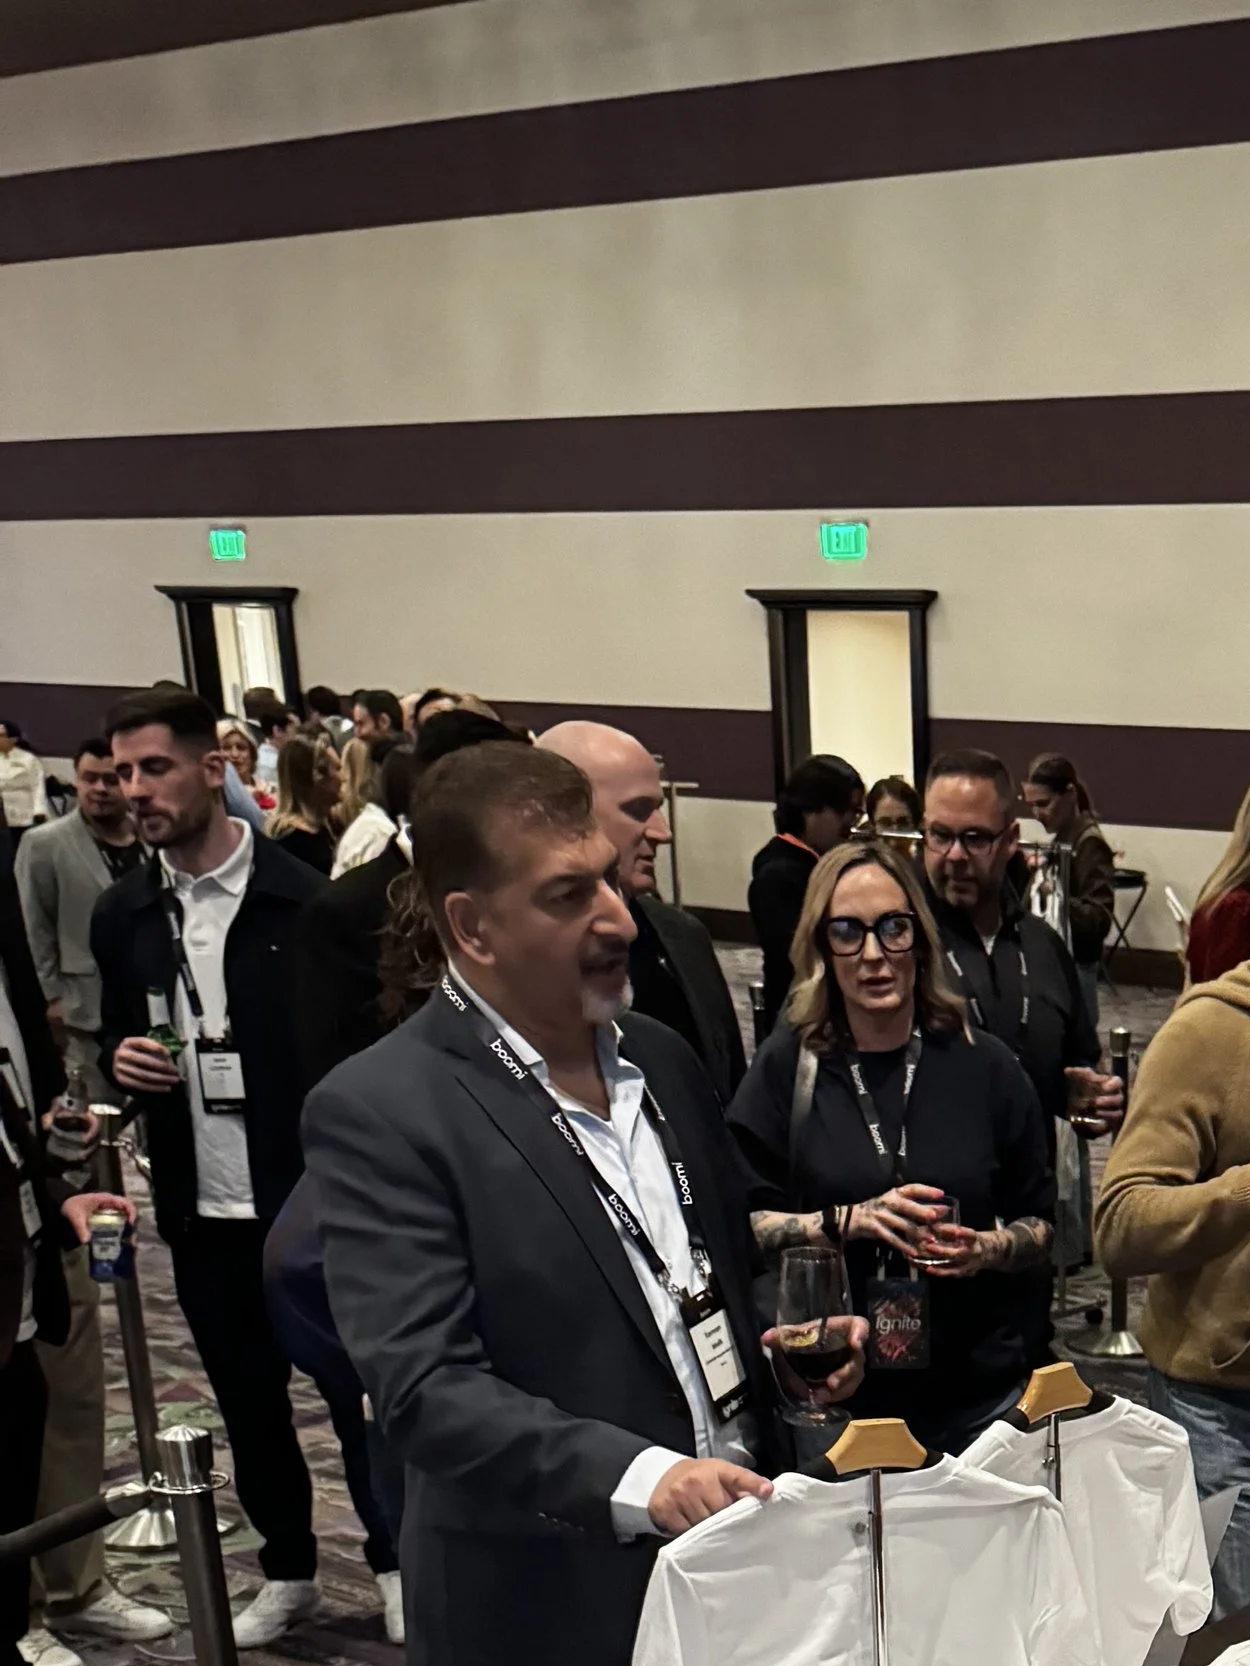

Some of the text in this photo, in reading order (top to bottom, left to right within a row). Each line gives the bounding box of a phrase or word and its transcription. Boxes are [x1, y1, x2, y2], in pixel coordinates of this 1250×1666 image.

[490, 1038, 528, 1080] boomi
[671, 1161, 694, 1205] boomi
[608, 1192, 641, 1237] boomi
